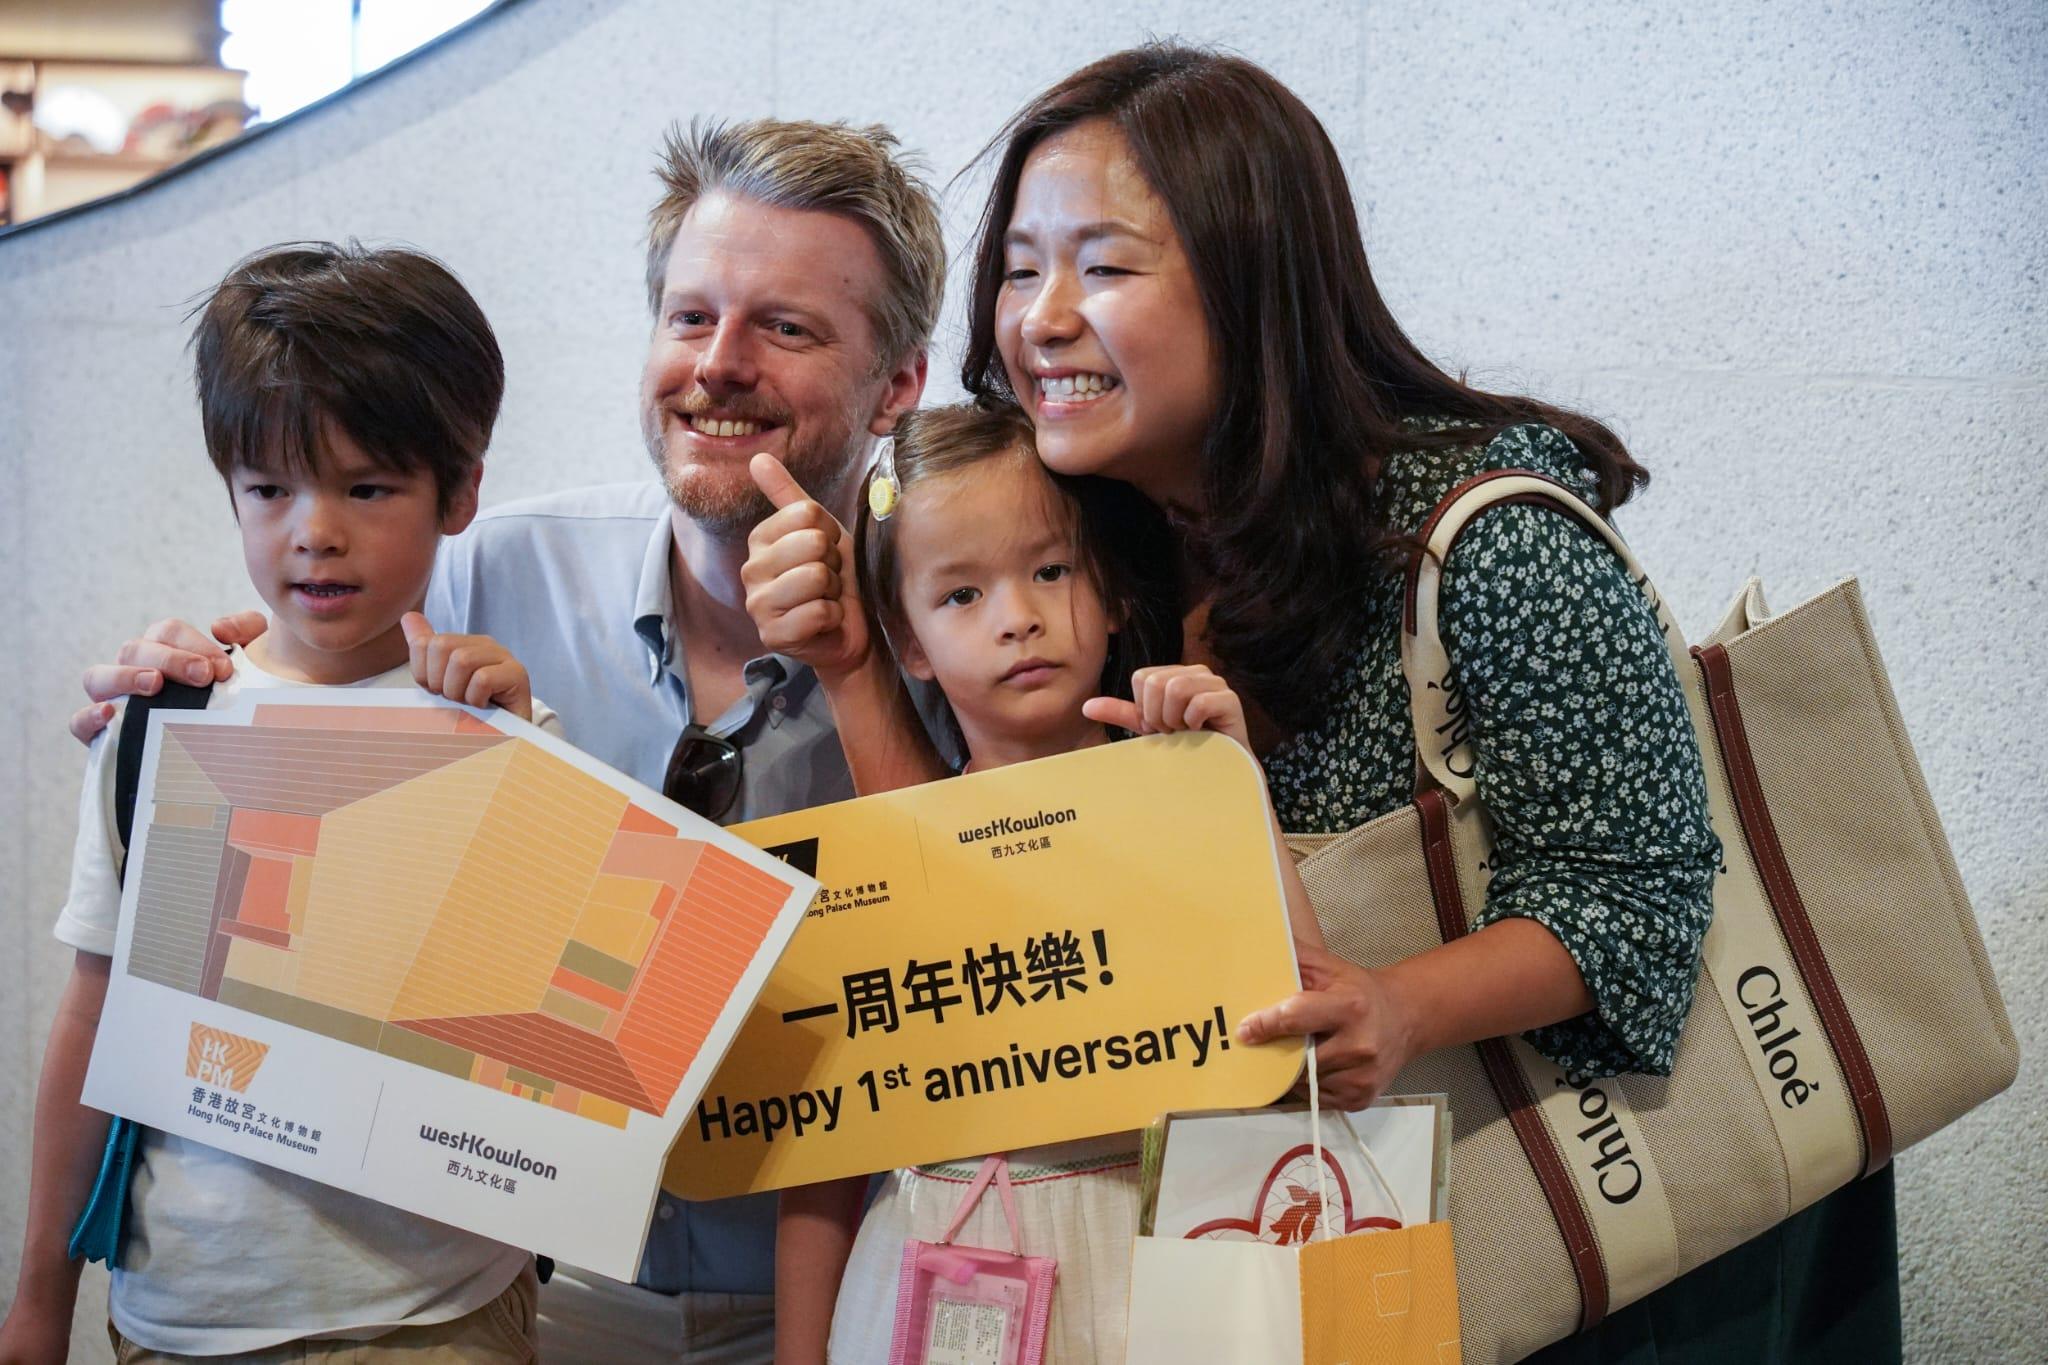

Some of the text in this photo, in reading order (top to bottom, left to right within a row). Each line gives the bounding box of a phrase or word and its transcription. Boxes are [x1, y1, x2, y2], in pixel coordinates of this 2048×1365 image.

[991, 836, 1052, 859] 西九文化區
[807, 894, 890, 918] ong Palace Museum
[201, 1037, 231, 1065] HK
[1737, 966, 1820, 1109] Chloé
[197, 1060, 235, 1089] PM
[697, 1006, 1231, 1142] Happy 1st anniversary!
[187, 1104, 318, 1155] Hong Kong Palace Museum
[192, 1086, 322, 1142] 香港故宮文化博物館
[446, 1159, 517, 1194] 西九文化區
